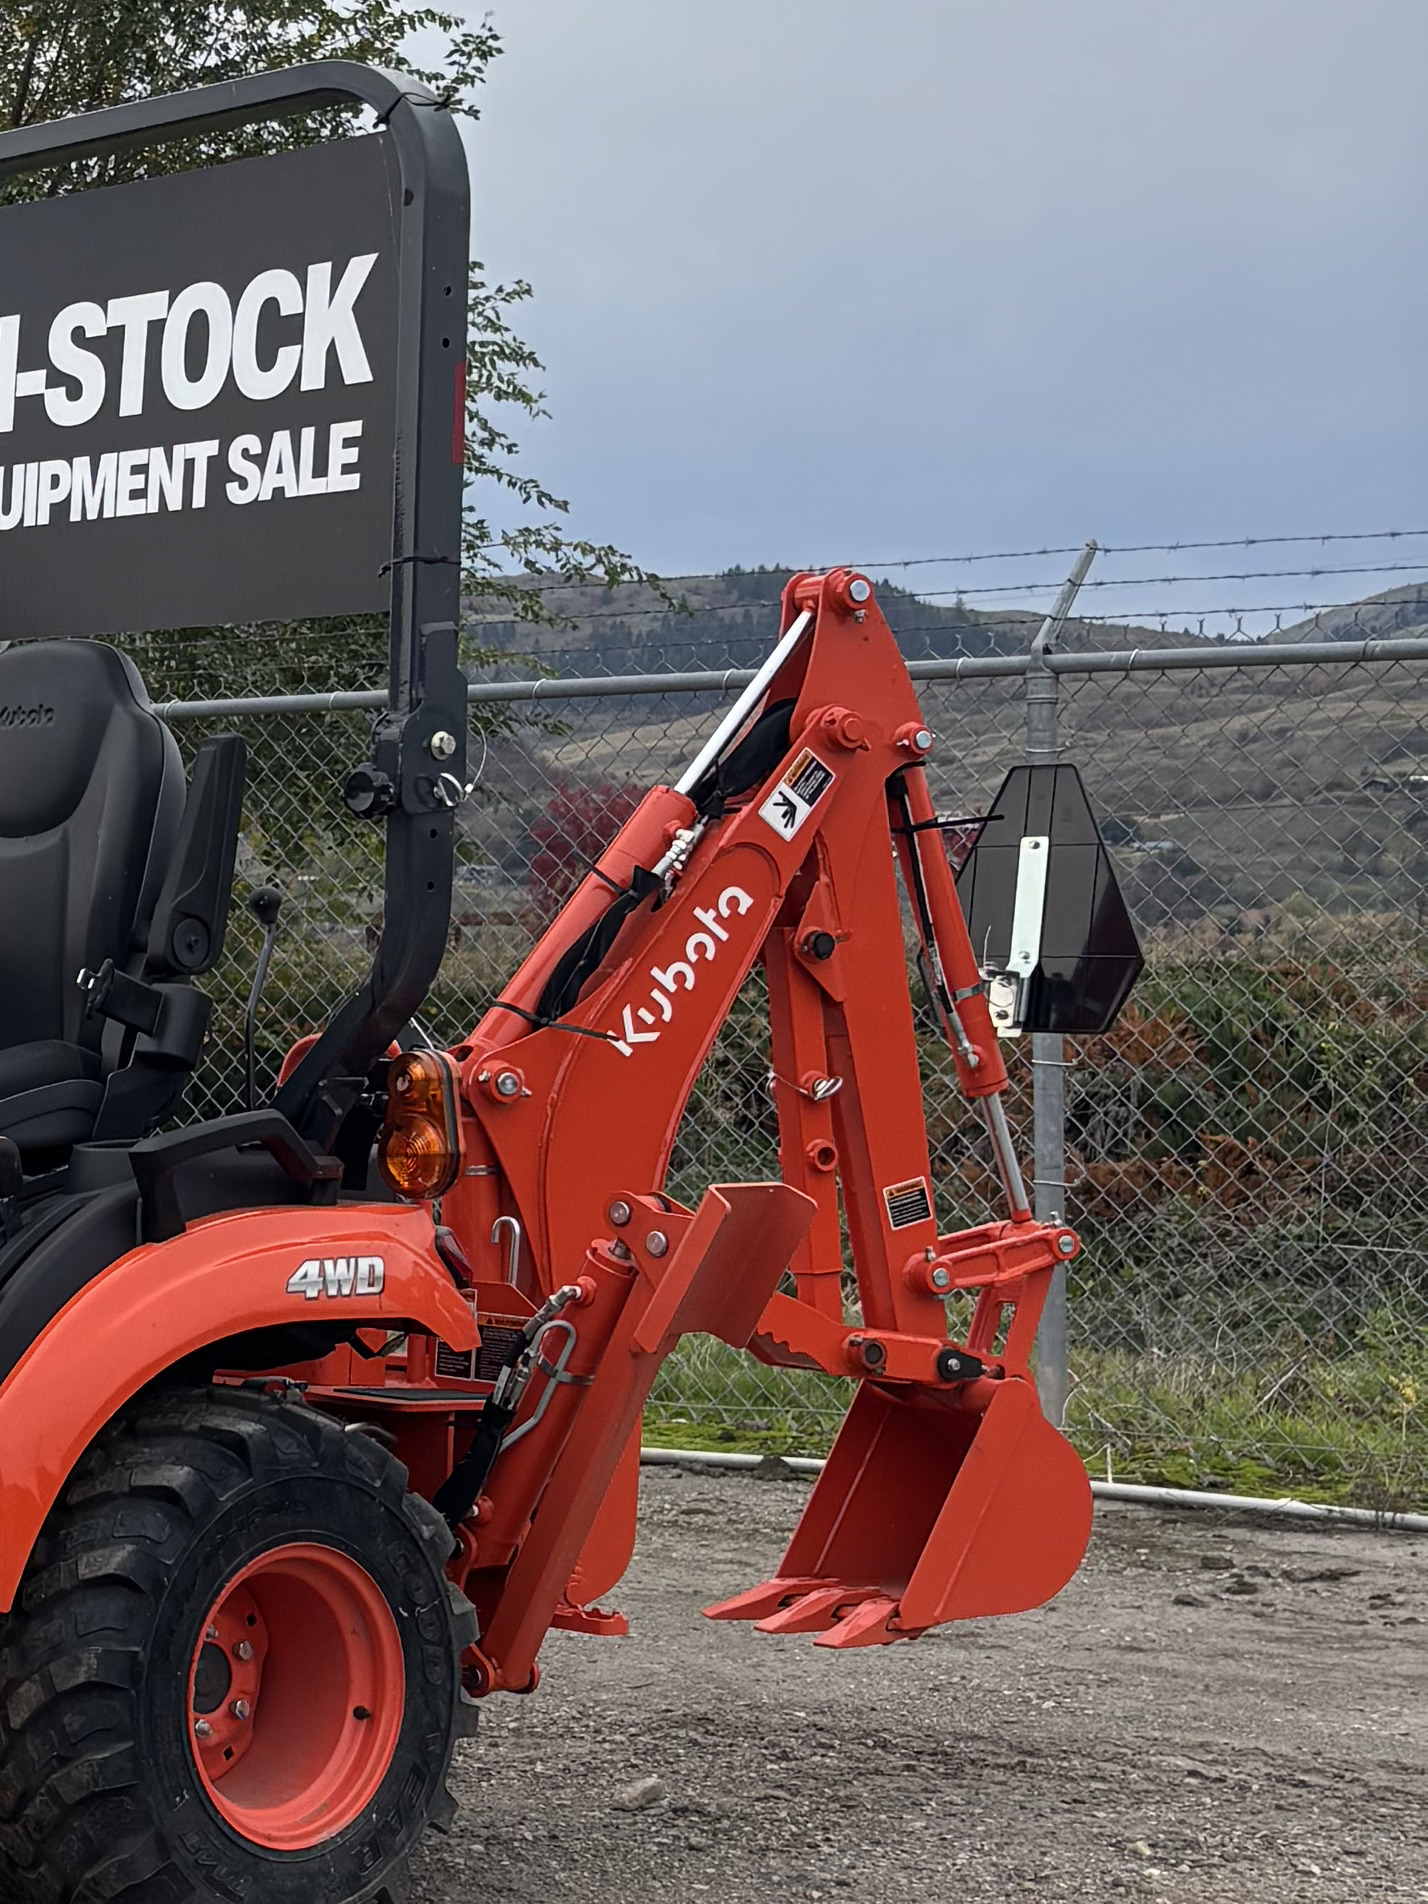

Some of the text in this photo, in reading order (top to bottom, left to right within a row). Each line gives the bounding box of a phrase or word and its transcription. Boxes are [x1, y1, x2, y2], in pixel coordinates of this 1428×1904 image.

[226, 420, 362, 506] SALE
[607, 886, 754, 1057] Kubota
[285, 1256, 386, 1300] 4WD
